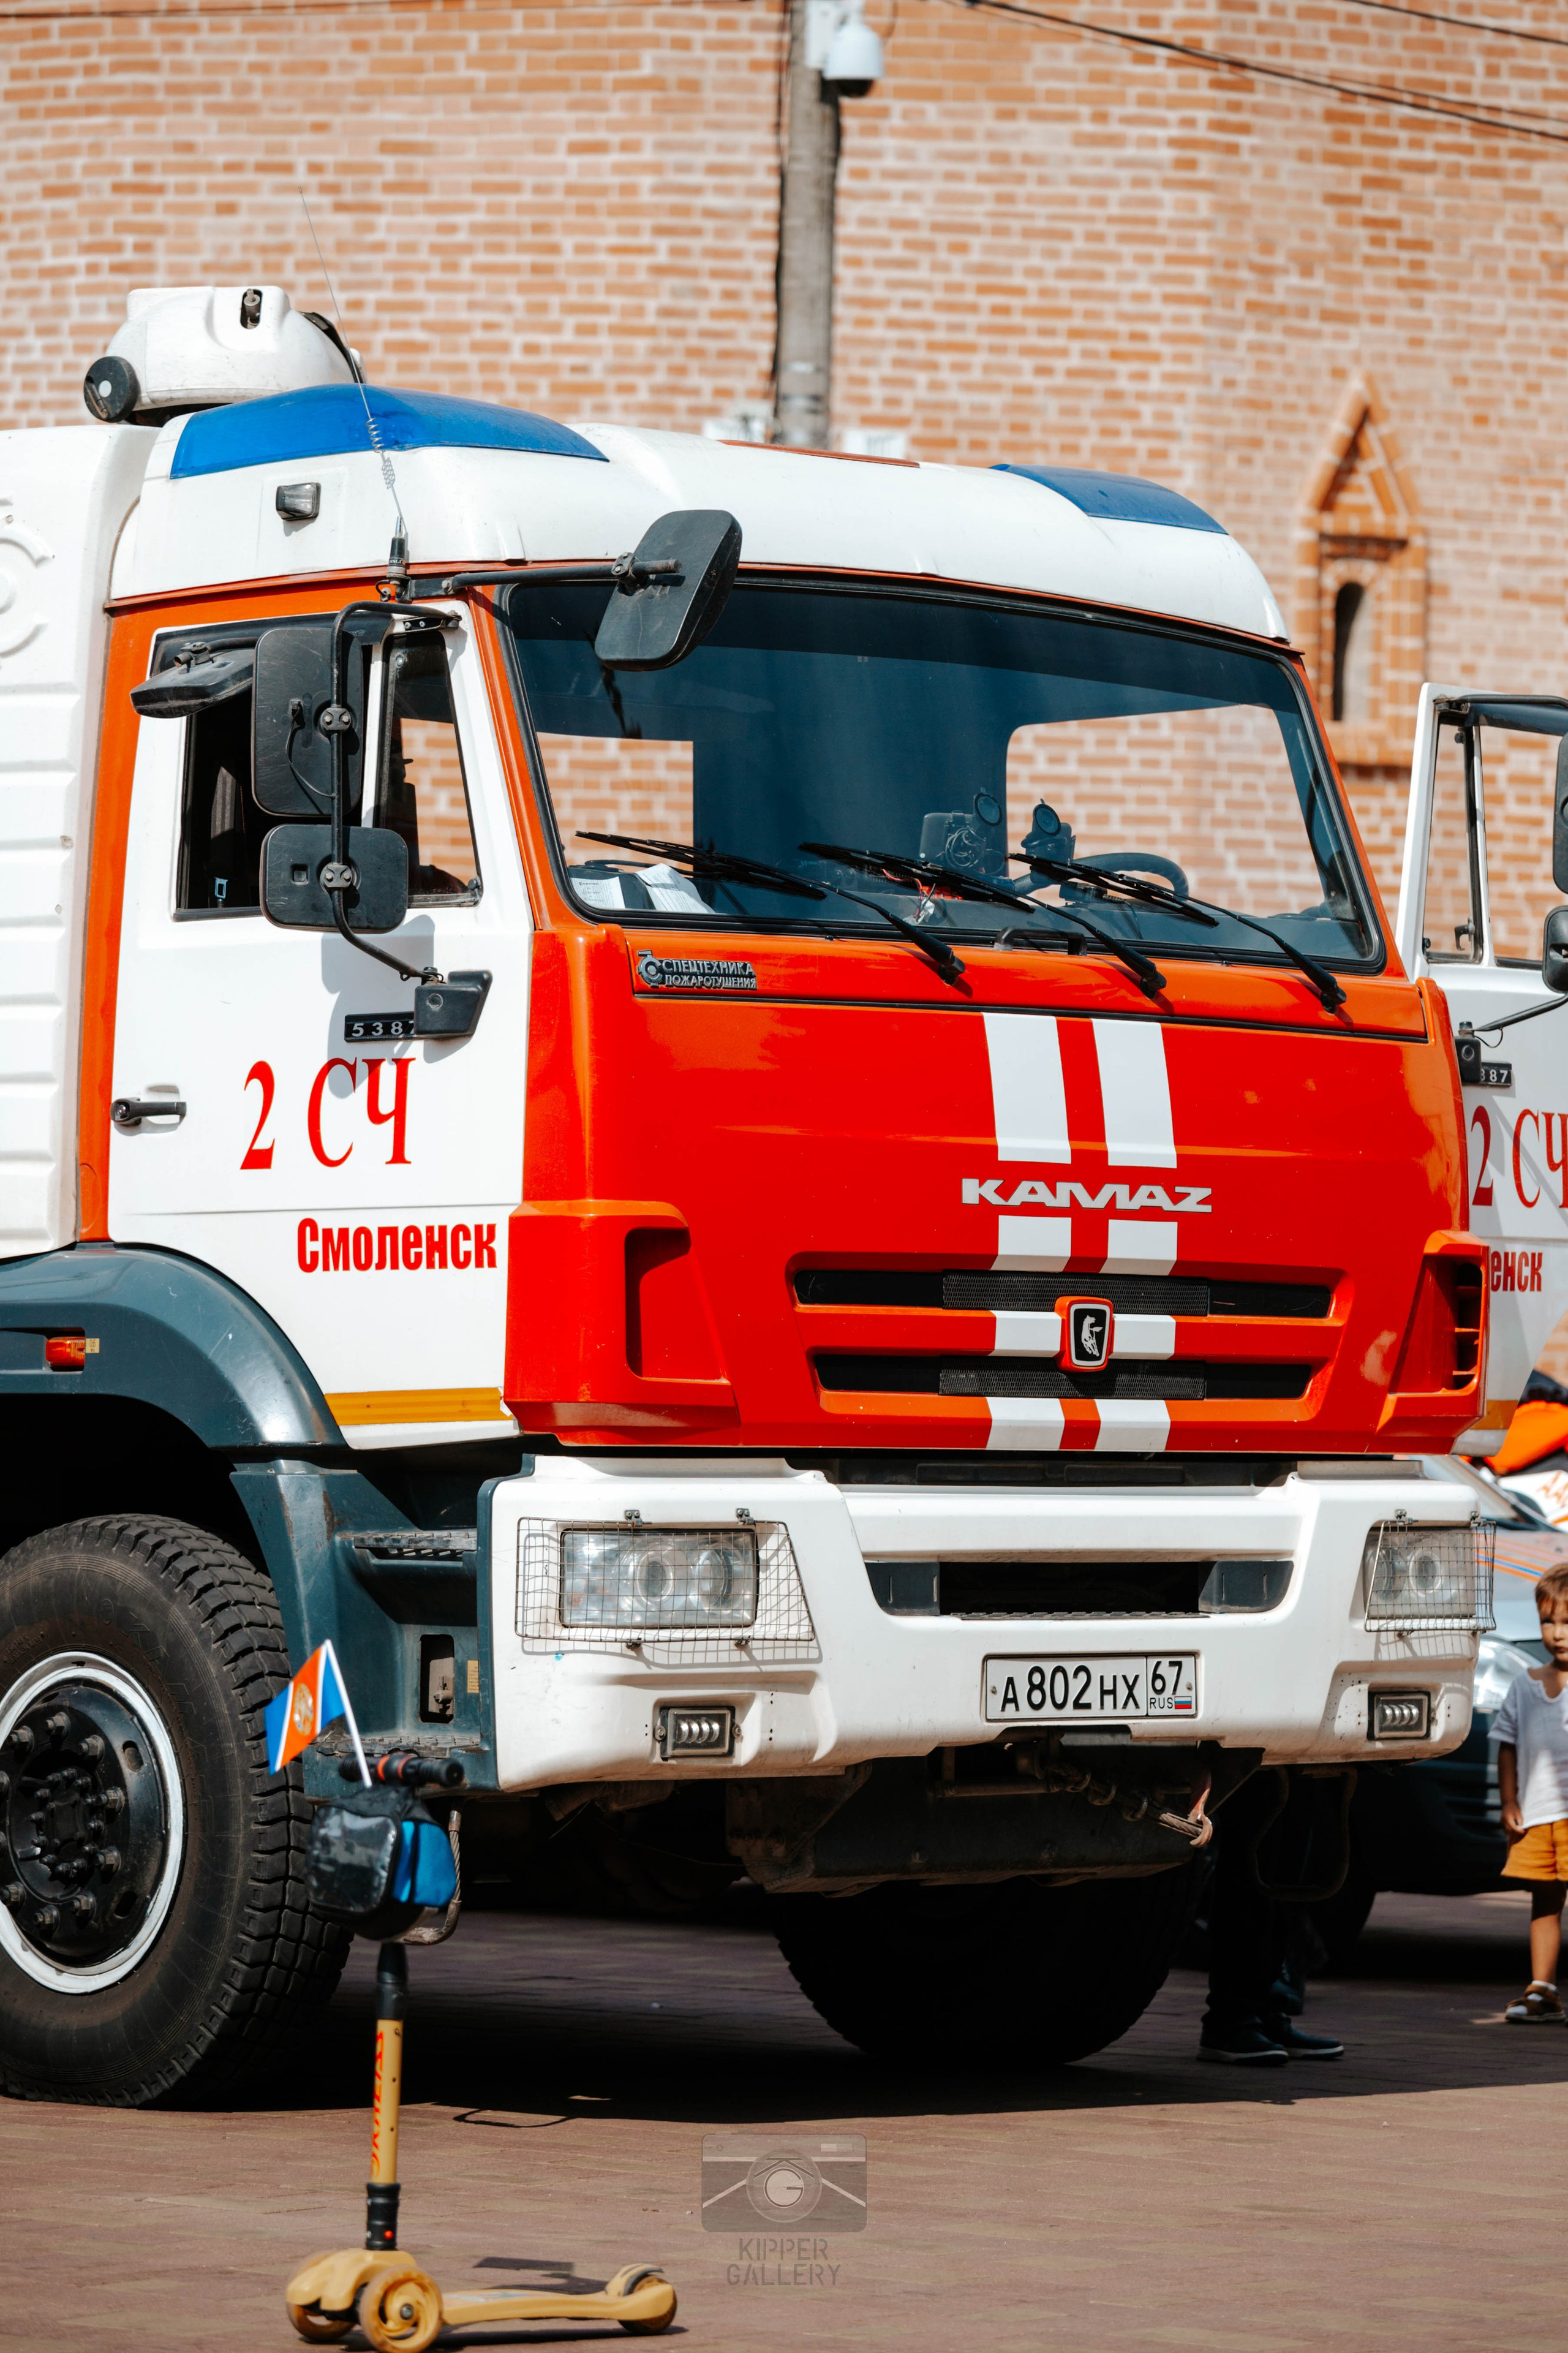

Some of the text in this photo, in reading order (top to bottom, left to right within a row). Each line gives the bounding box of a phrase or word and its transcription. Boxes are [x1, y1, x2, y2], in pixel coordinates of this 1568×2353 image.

[662, 959, 755, 975] СПЕЦТЕХНИКА
[665, 974, 757, 989] ПОЖАРОТУШЕНИЯ
[240, 1057, 417, 1170] 2 СЧ
[1471, 1105, 1568, 1209] 2 СЧ
[962, 1177, 1213, 1213] KAMAZ
[297, 1218, 497, 1273] Смоленск
[1490, 1250, 1542, 1293] енск
[1001, 1661, 1183, 1711] А802НХ 67
[1150, 1697, 1174, 1709] RUS
